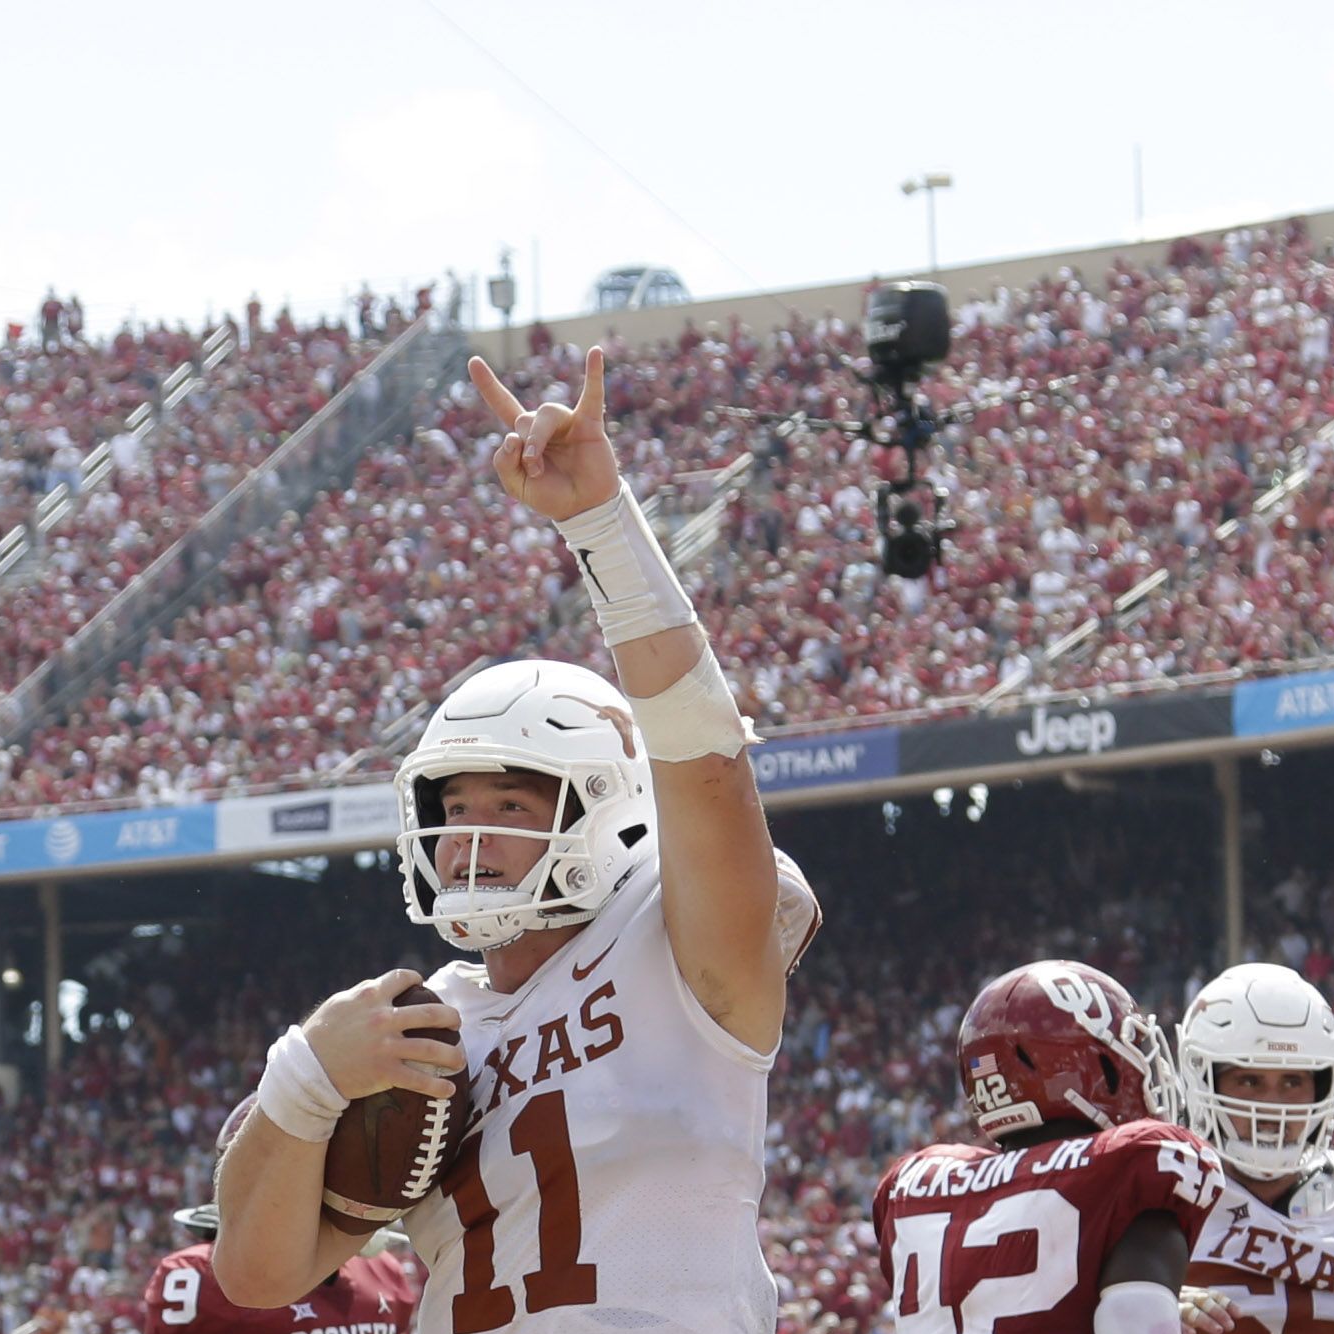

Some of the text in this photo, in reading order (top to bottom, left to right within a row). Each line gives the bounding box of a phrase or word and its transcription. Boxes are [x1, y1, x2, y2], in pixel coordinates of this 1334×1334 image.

[1016, 707, 1116, 754] Jeep
[116, 817, 179, 849] AT&T
[1039, 970, 1113, 1043] OU
[975, 1073, 1013, 1111] 42
[1032, 1137, 1090, 1175] JR.
[162, 1267, 200, 1324] 9
